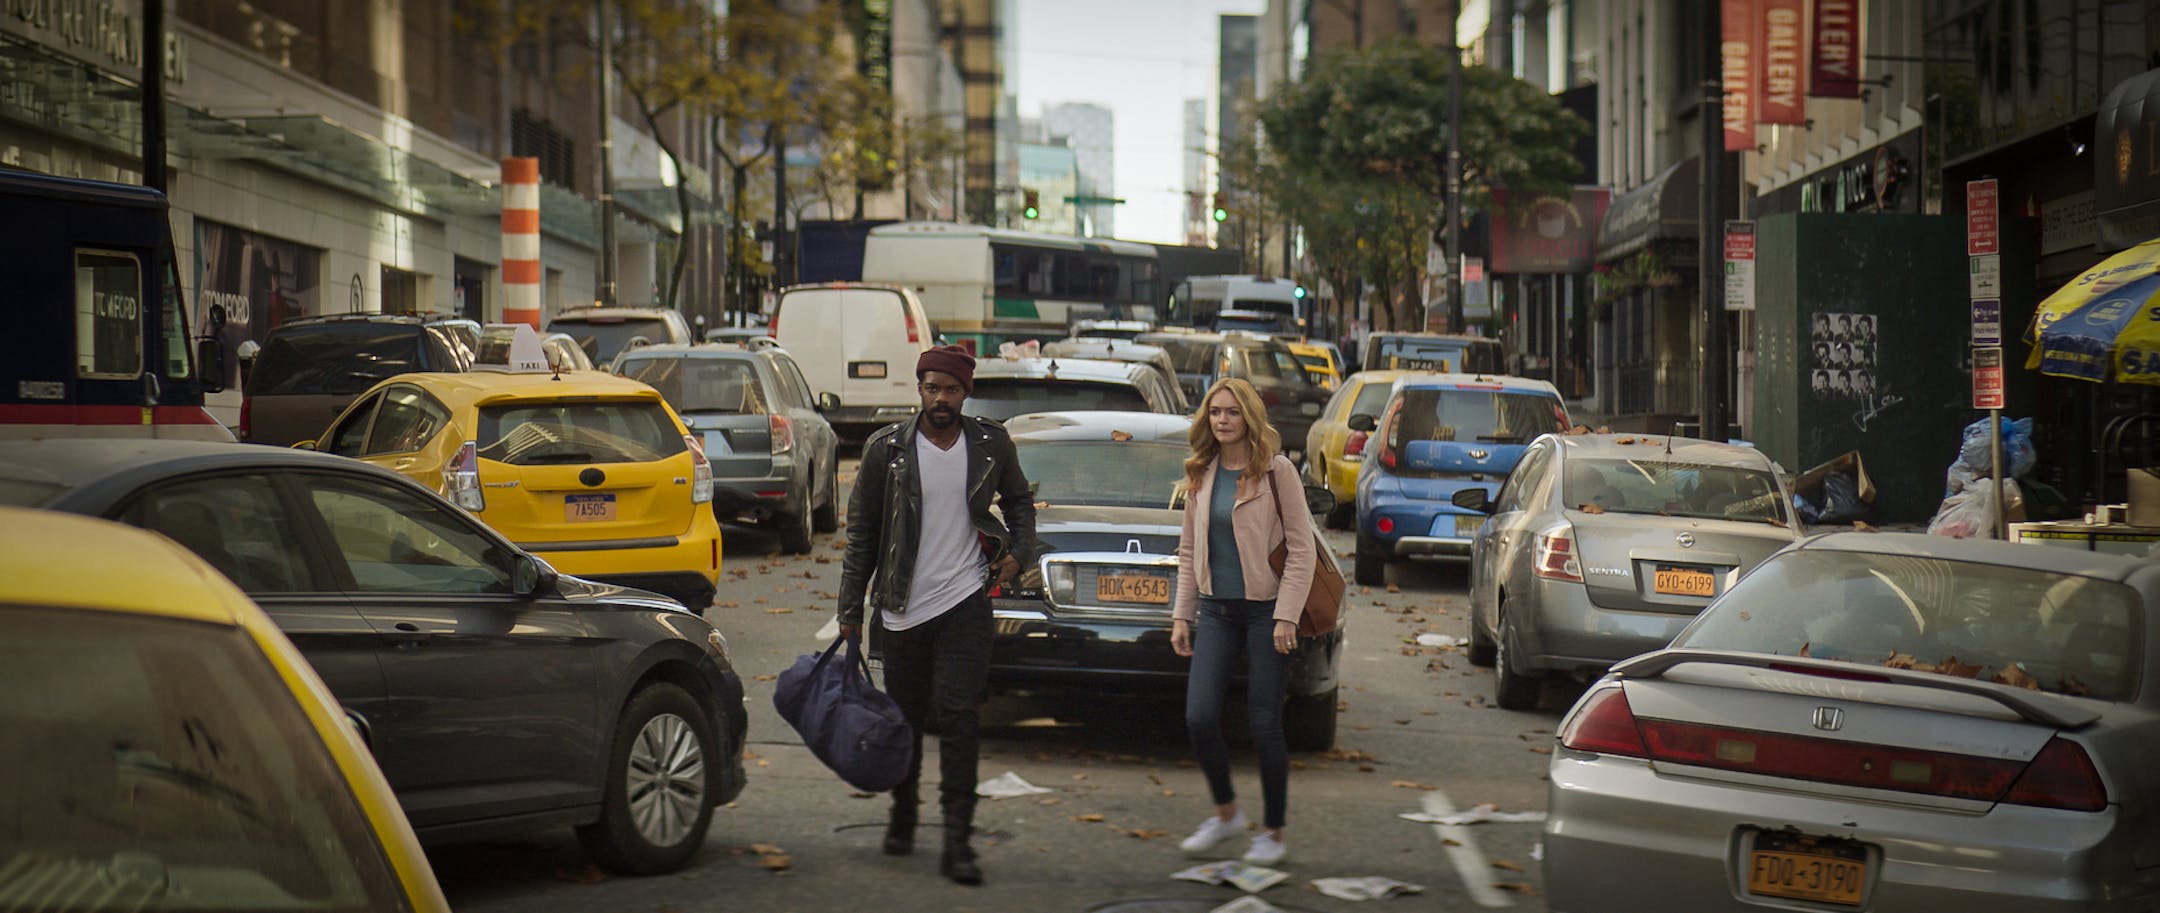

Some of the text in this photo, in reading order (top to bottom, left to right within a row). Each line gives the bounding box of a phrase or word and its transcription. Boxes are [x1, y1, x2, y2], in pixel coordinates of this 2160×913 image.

[1820, 0, 1849, 76] LLERY
[1766, 8, 1798, 107] GALLERY
[1722, 41, 1749, 134] GALLERY
[226, 292, 250, 324] FORD
[520, 362, 540, 370] TAXI
[575, 502, 607, 516] 7A505
[1588, 566, 1629, 577] SENTRA
